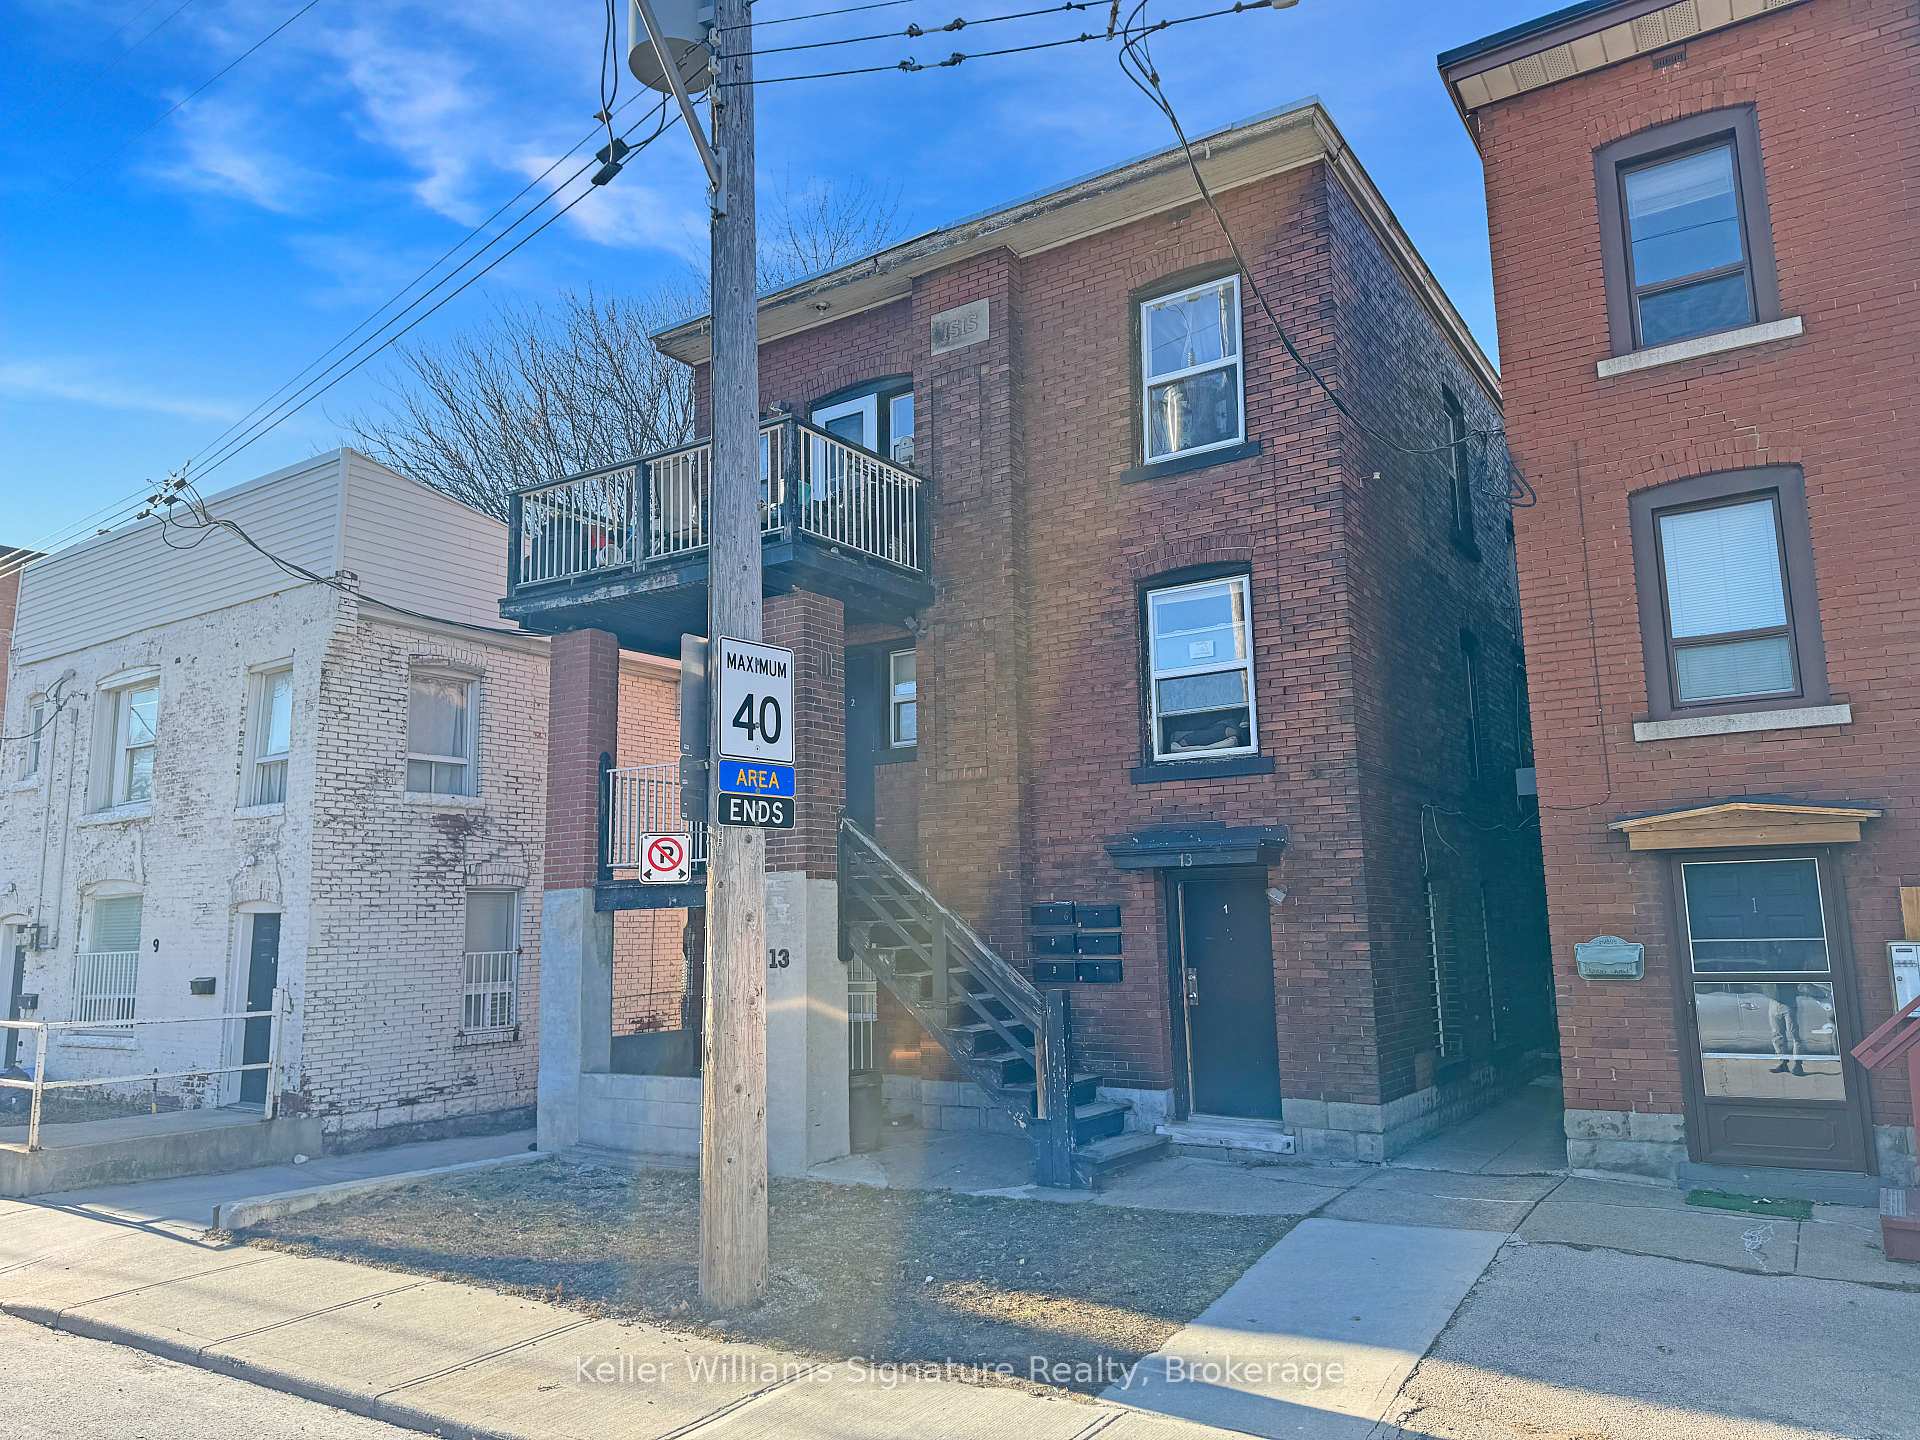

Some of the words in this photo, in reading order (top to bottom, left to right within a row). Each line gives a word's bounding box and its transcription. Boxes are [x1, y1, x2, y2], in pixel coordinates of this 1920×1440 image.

[727, 651, 787, 679] MAXIMUM
[732, 693, 782, 745] 40
[736, 768, 780, 790] AREA
[730, 798, 784, 824] ENDS
[660, 846, 674, 864] P
[1180, 853, 1193, 867] 13
[1223, 903, 1229, 914] 1
[153, 938, 160, 953] 9
[769, 948, 790, 969] 13
